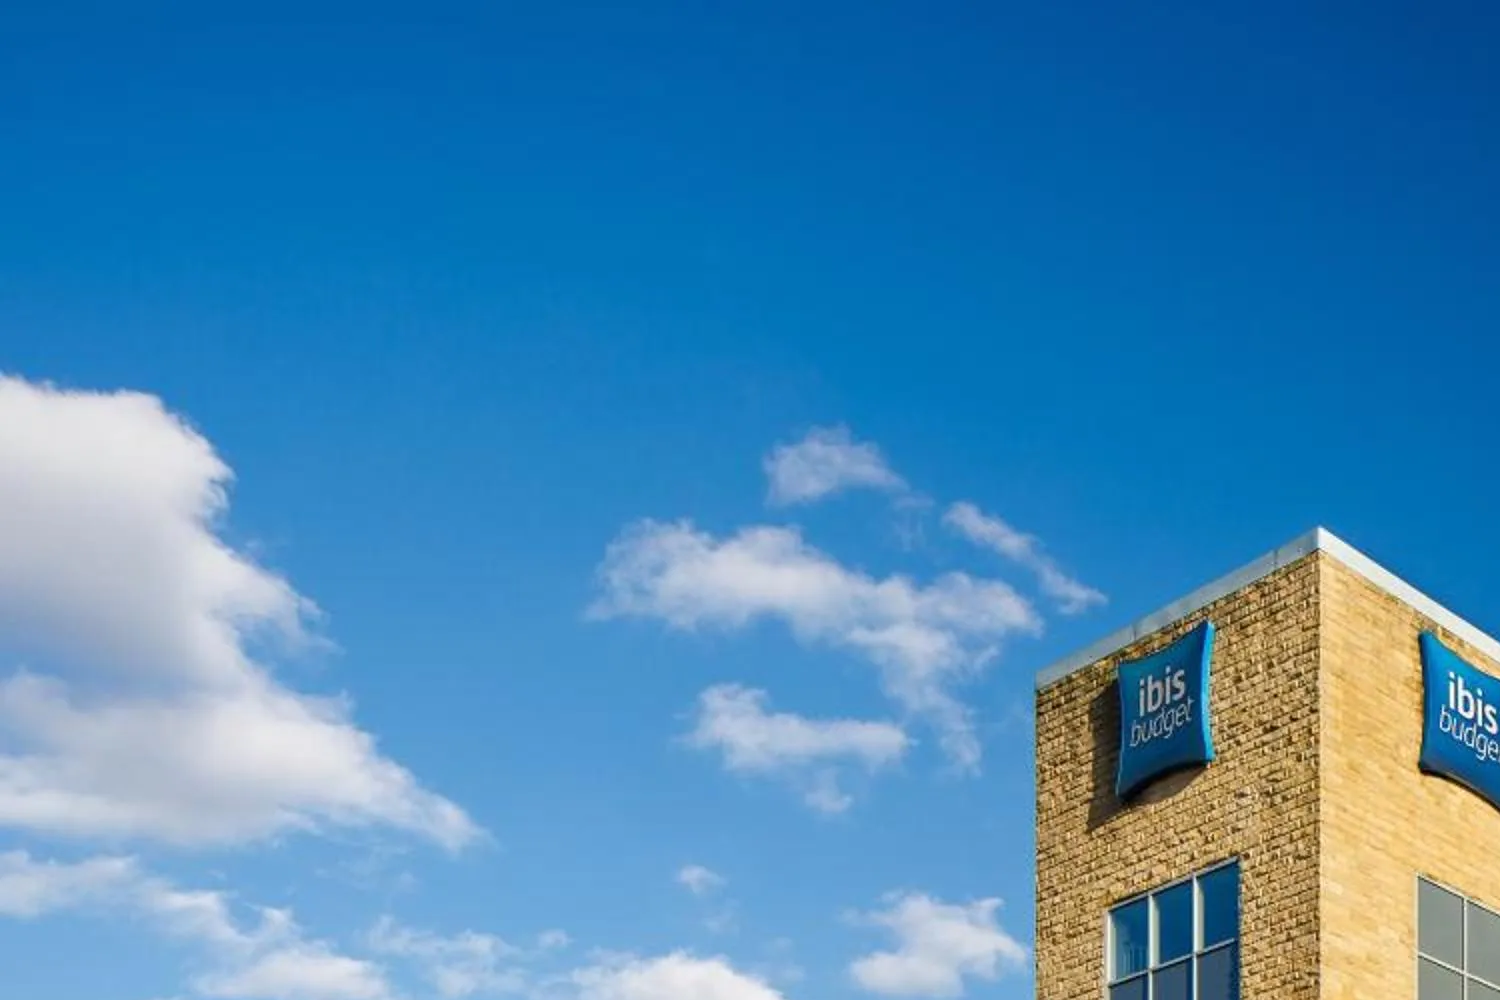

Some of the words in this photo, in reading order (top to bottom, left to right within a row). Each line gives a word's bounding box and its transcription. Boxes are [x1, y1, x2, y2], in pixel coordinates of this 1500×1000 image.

[1139, 666, 1186, 716] ibis
[1449, 671, 1499, 734] ibis
[1129, 698, 1194, 748] budget
